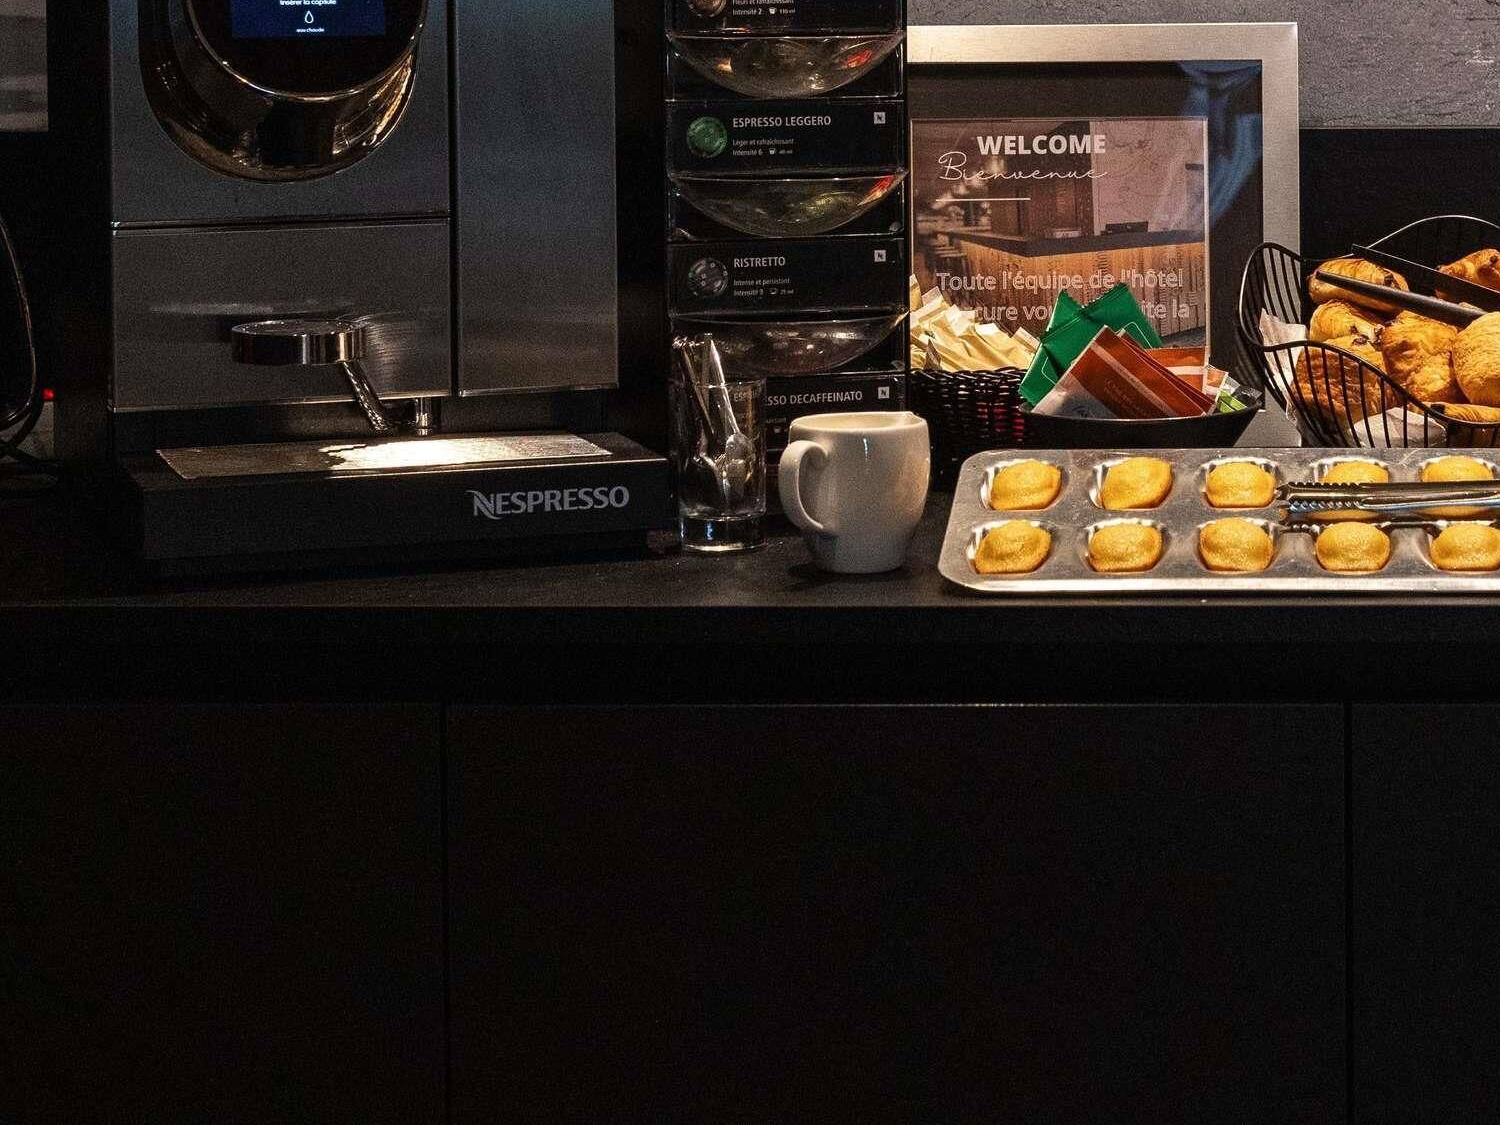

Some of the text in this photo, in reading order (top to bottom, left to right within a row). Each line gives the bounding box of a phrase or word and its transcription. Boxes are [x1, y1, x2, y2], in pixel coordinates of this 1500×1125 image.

[311, 0, 337, 7] capsule
[758, 7, 763, 15] 2
[732, 117, 783, 128] ESPRESSO
[785, 116, 832, 127] LEGGERO
[977, 135, 1107, 155] WELCOME
[938, 151, 1109, 181] Bienvenue
[733, 256, 786, 269] RISTRETTO
[936, 267, 1184, 295] Toute l'équipe de l'hôtel
[975, 305, 1018, 321] cure
[1172, 299, 1190, 318] la
[790, 390, 864, 405] DECAFFEINATO
[466, 486, 630, 520] NESPRESSO
